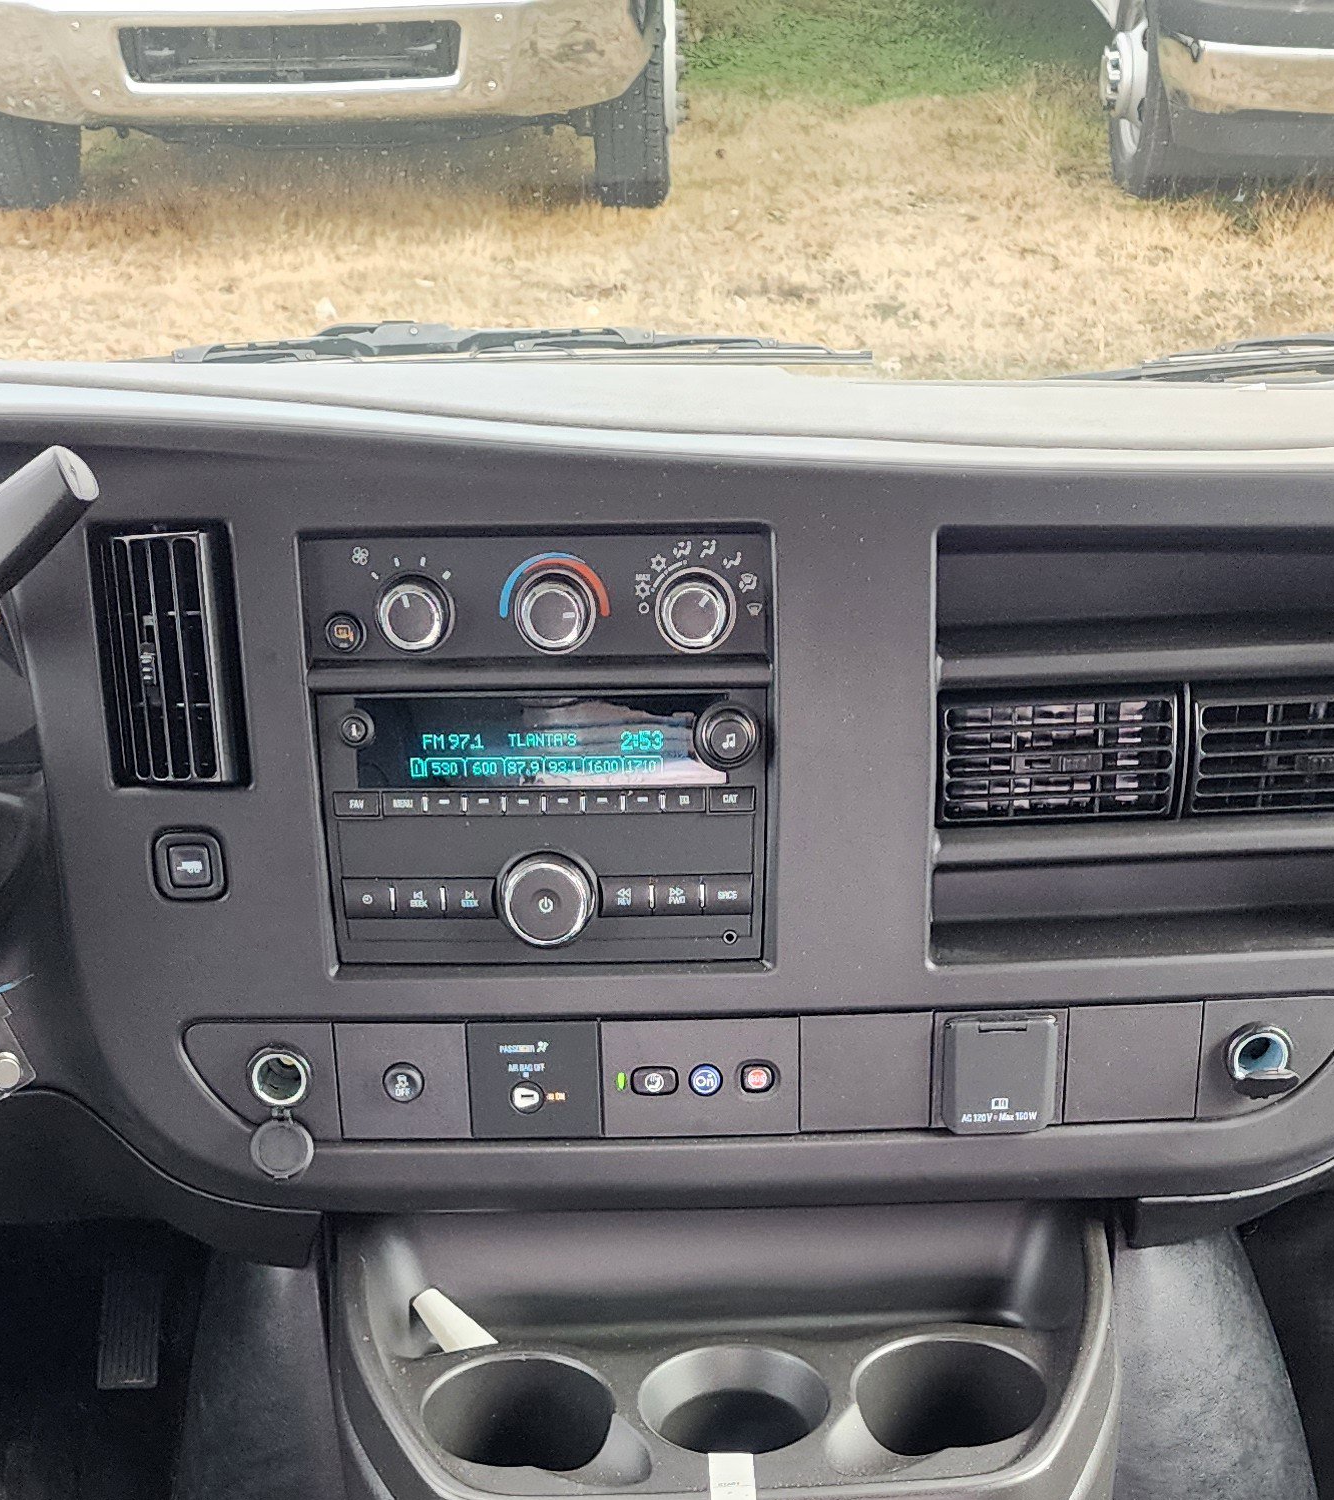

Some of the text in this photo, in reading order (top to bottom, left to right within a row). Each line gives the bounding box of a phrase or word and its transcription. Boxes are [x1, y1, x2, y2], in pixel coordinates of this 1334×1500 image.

[423, 734, 445, 750] FM
[448, 733, 484, 751] 97.1
[620, 730, 664, 751] 2:53
[431, 762, 458, 776] 530
[472, 762, 497, 776] 600
[508, 761, 539, 776] 87.9
[548, 761, 577, 774] 93.1
[588, 760, 618, 773] 1600
[625, 760, 656, 773] 1710
[349, 799, 364, 809] FAV
[722, 794, 738, 804] CAT
